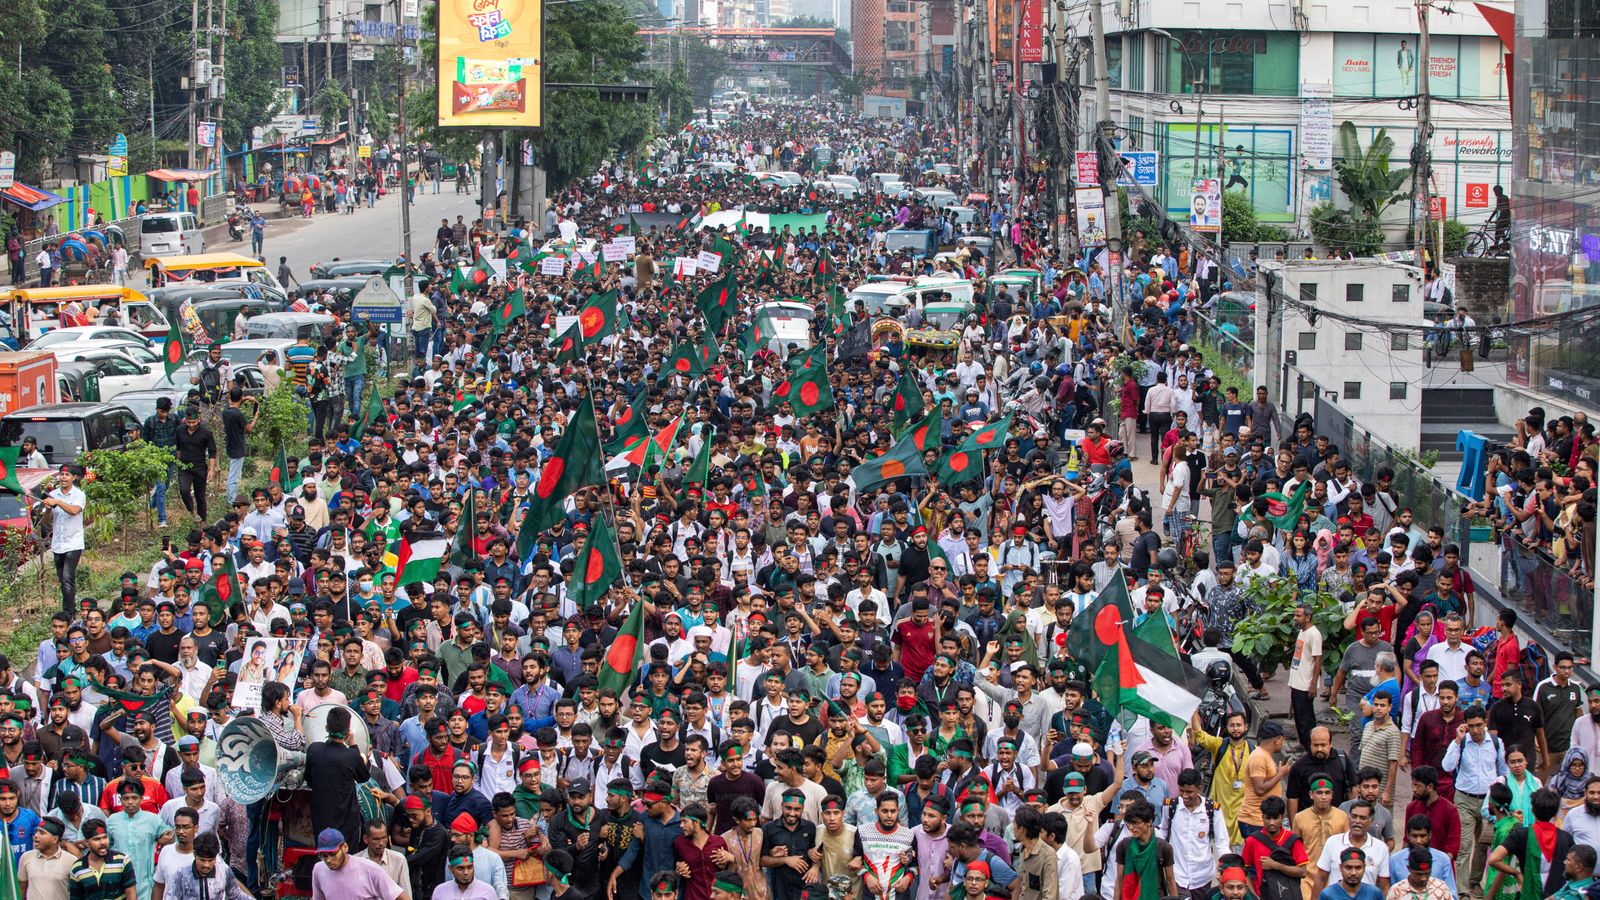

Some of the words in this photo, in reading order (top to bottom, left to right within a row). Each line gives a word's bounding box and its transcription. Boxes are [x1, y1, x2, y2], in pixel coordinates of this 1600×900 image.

[468, 11, 501, 27] ফান
[480, 20, 512, 41] ফিল
[1429, 56, 1457, 64] TRENDY
[1443, 135, 1494, 148] Surprisingly
[1459, 146, 1512, 157] Rewarding
